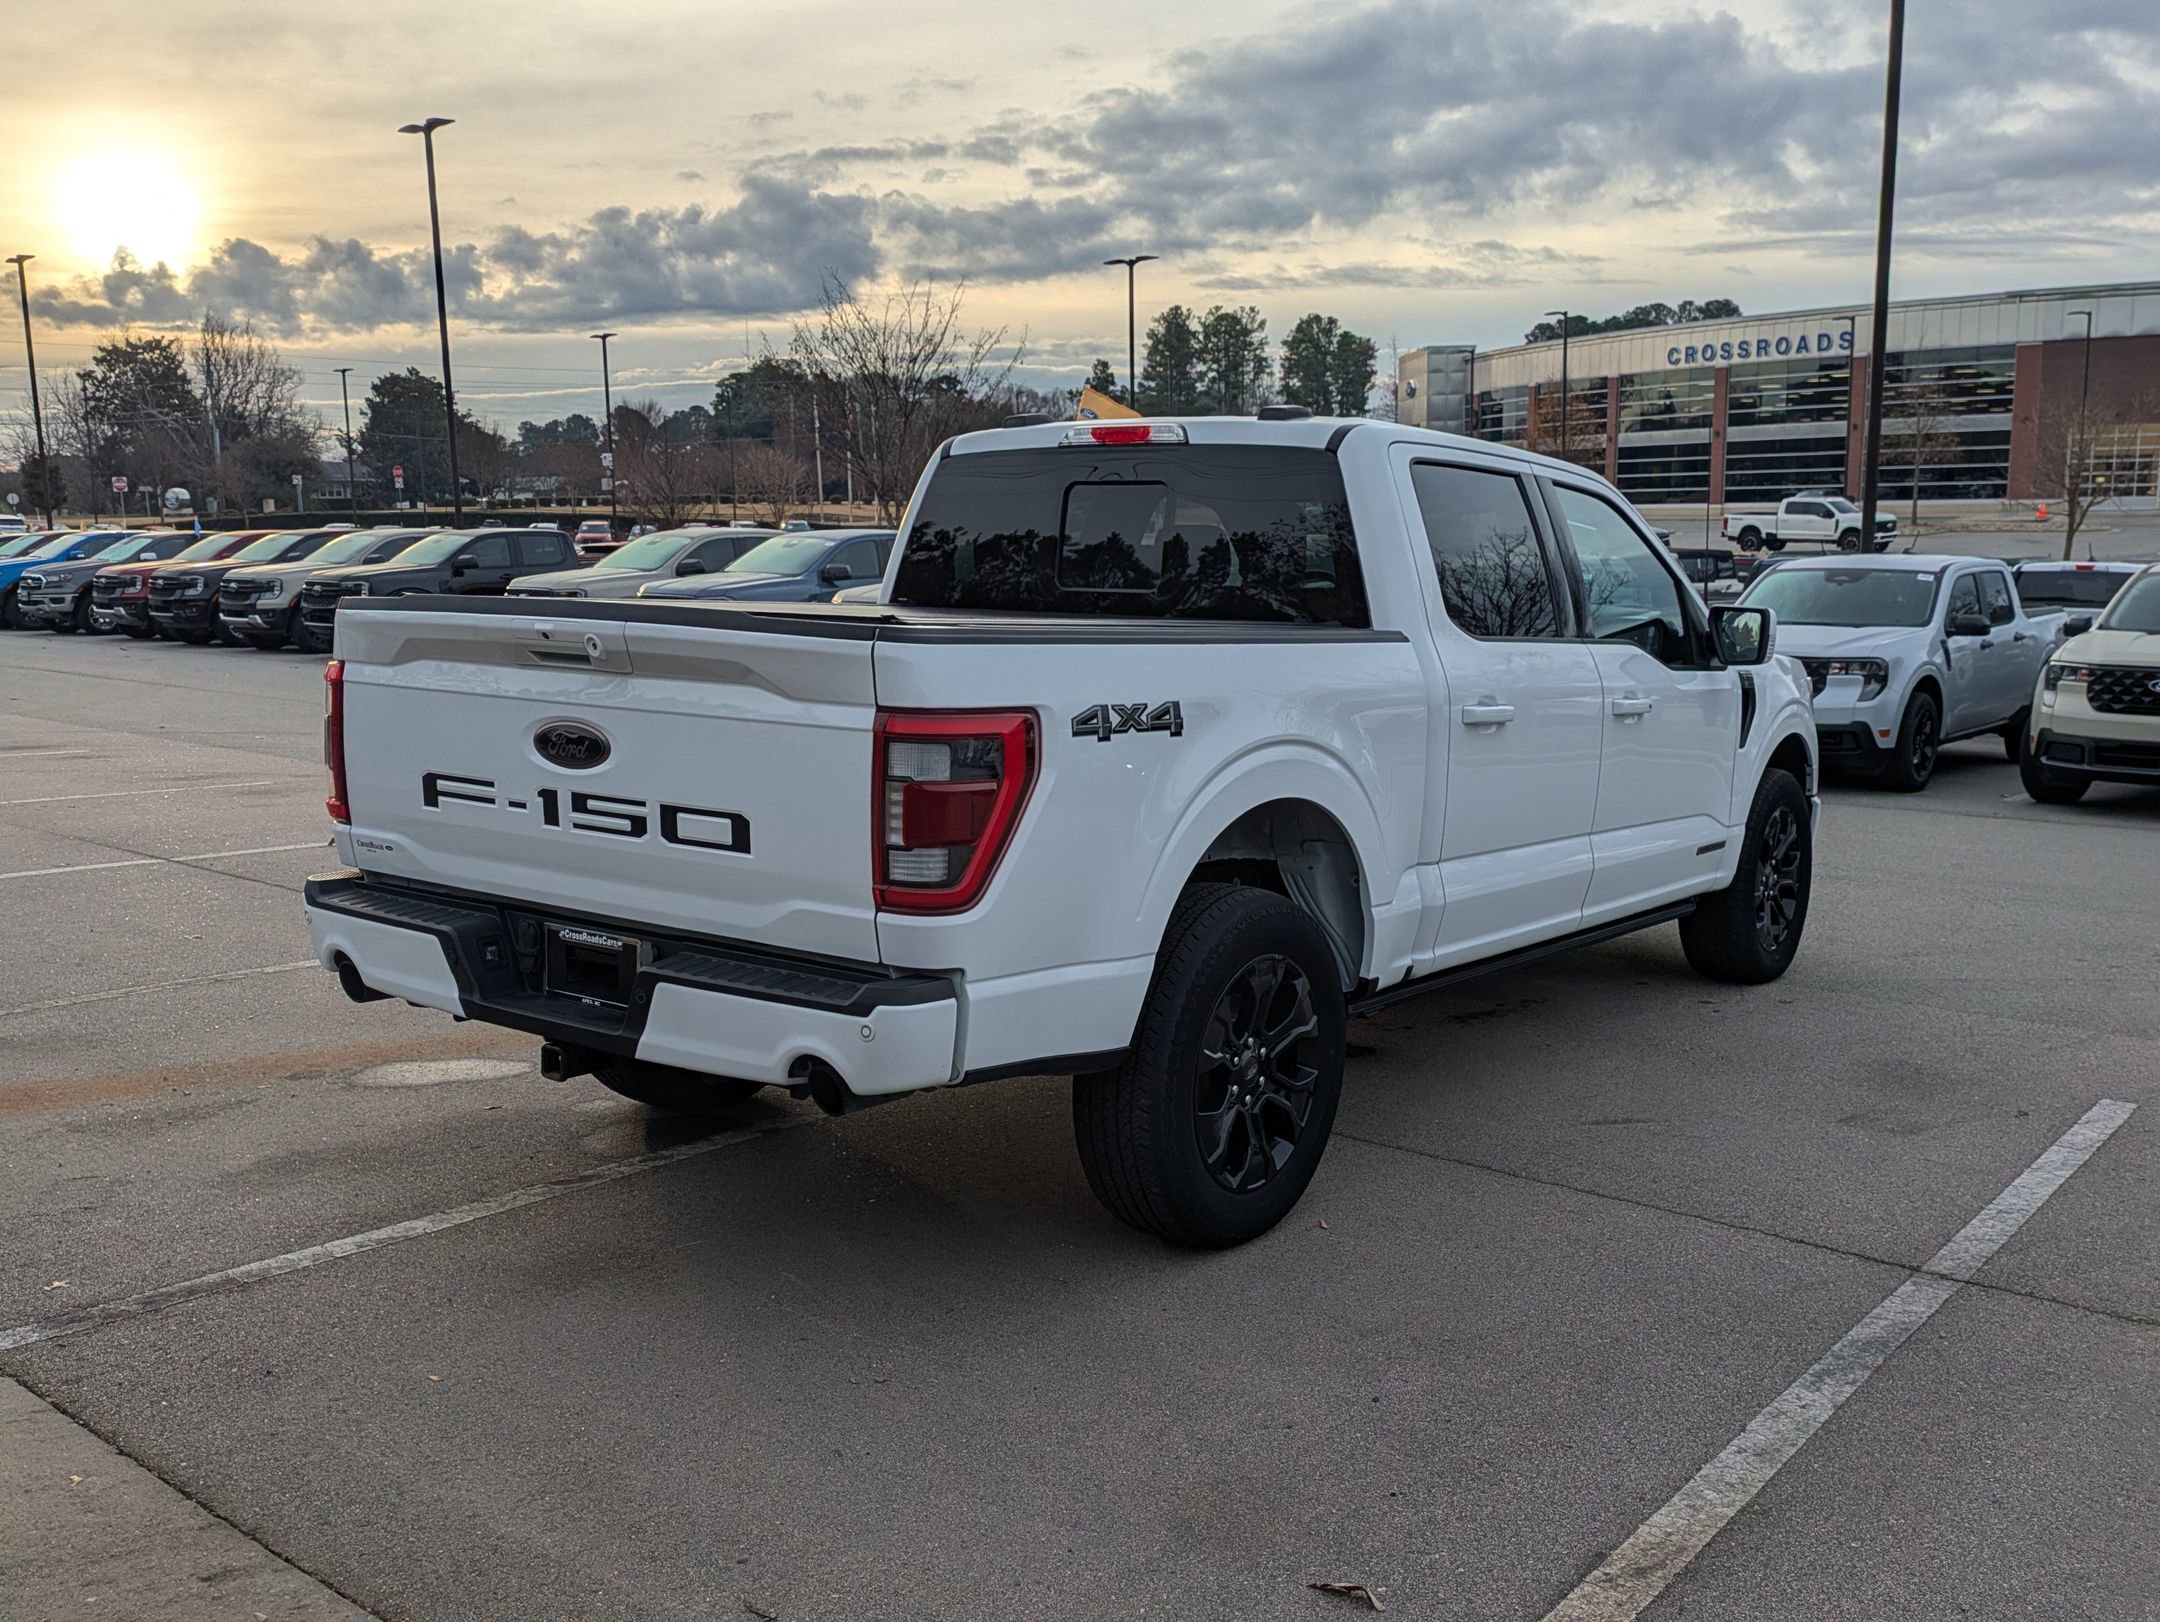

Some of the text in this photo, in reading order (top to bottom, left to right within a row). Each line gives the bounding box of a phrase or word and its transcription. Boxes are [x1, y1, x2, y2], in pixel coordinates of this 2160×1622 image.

[1667, 331, 1852, 366] CROSSROADS
[547, 730, 590, 759] Ford
[421, 771, 752, 856] F-150
